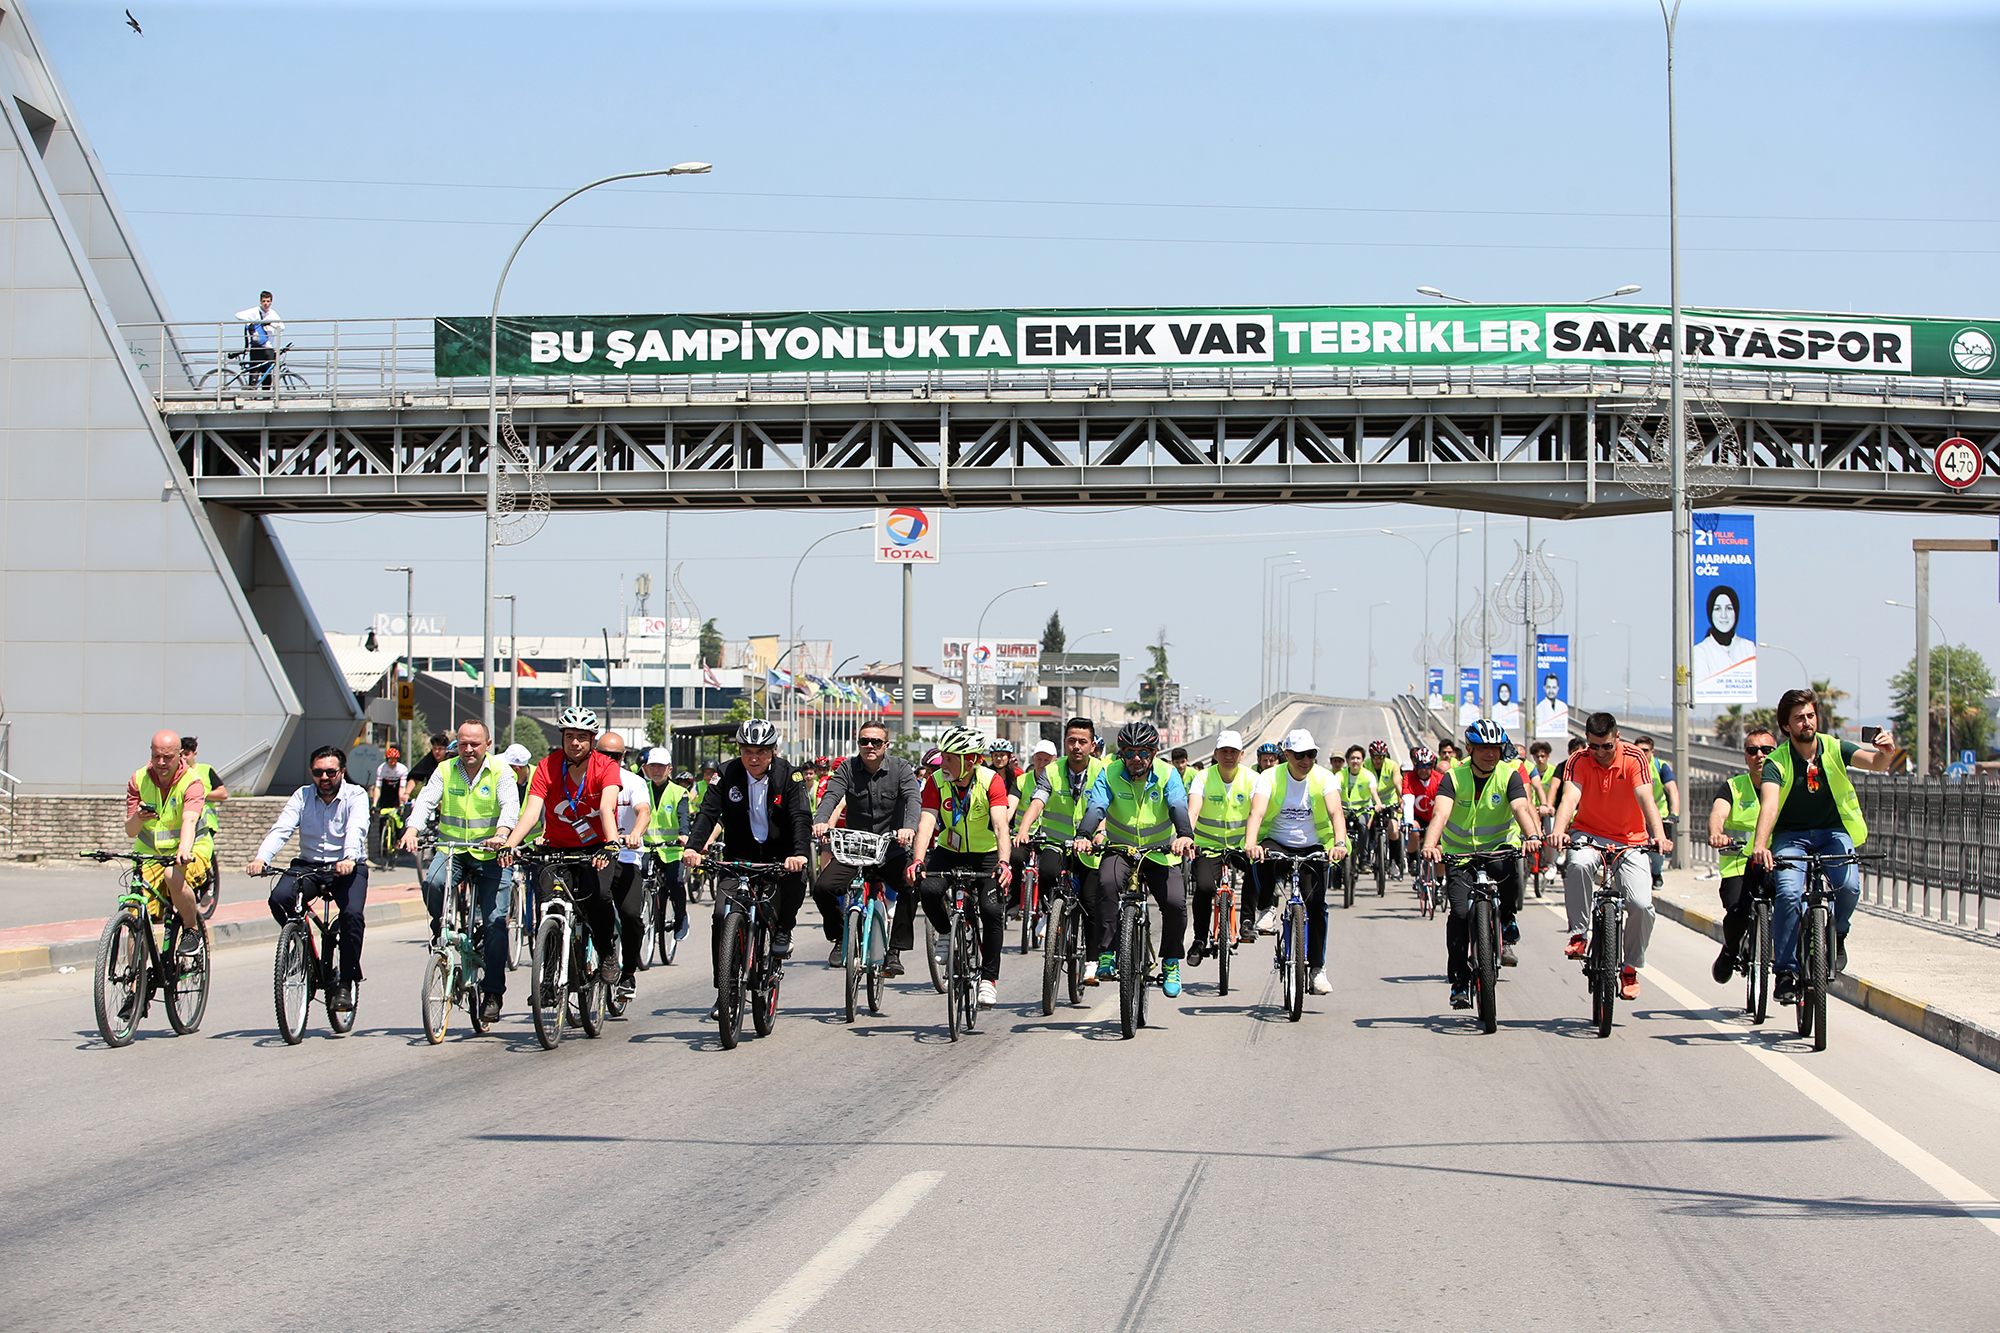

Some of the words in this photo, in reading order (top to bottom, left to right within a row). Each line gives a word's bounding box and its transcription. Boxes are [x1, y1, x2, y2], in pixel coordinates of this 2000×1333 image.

[530, 331, 593, 364] BU
[605, 320, 1012, 369] ŞAMPİYONLUKTA
[1025, 322, 1155, 356] EMEK
[1169, 322, 1267, 355] VAR
[1278, 312, 1541, 354] TEBRİKLER
[1552, 319, 1903, 364] SAKARYASPOR
[1695, 529, 1714, 546] 21
[880, 547, 934, 559] TOTAL
[1695, 553, 1752, 565] MARMARA
[1695, 563, 1720, 576] GÖZ
[1537, 642, 1548, 652] 21
